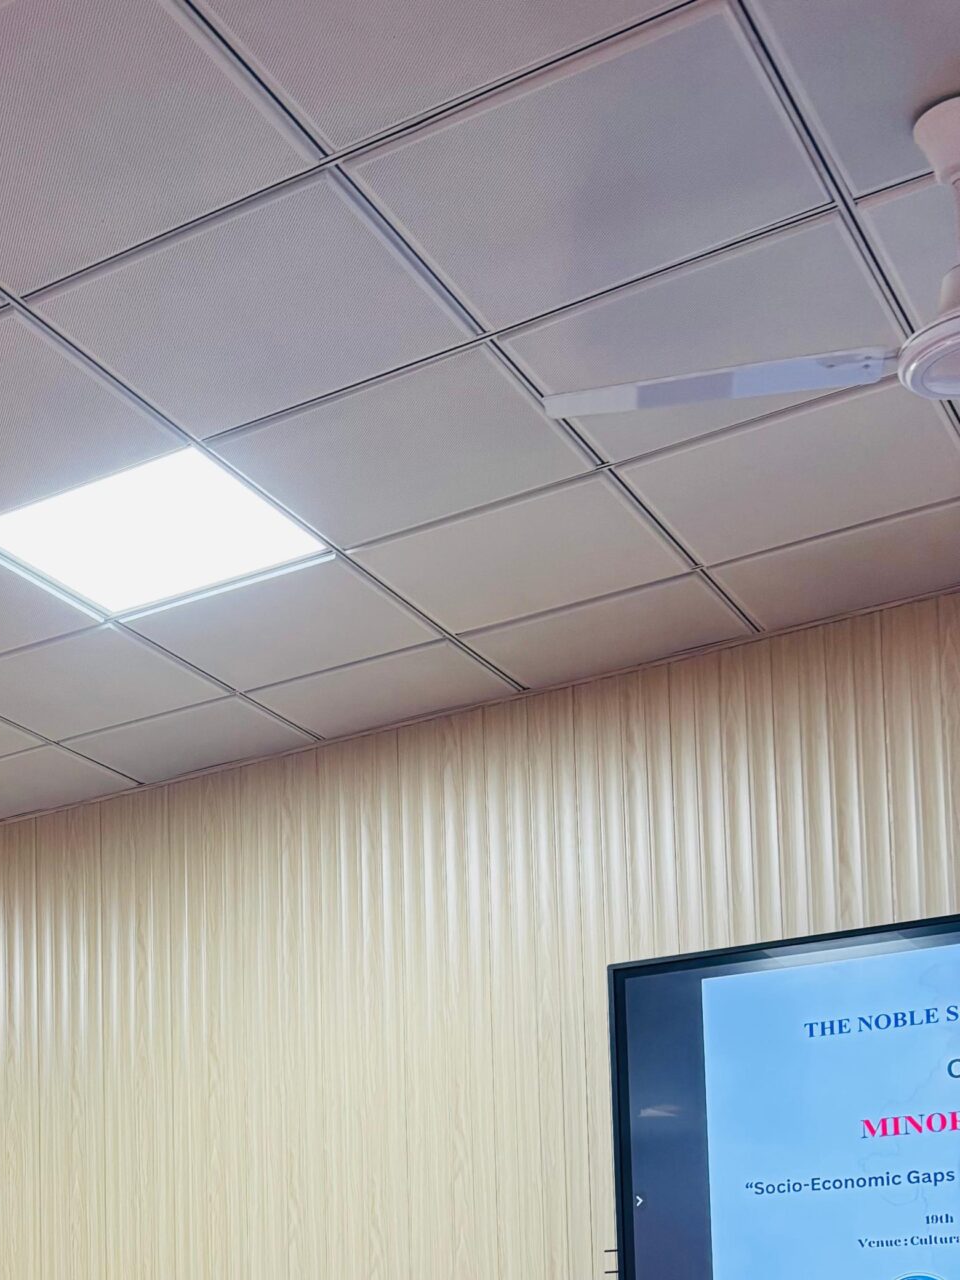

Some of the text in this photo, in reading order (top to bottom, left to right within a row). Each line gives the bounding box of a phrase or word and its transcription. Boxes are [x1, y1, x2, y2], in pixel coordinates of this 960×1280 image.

[804, 1005, 960, 1038] THE NOBLE S
[907, 1169, 955, 1186] Gaps
[925, 1213, 954, 1224] 19th
